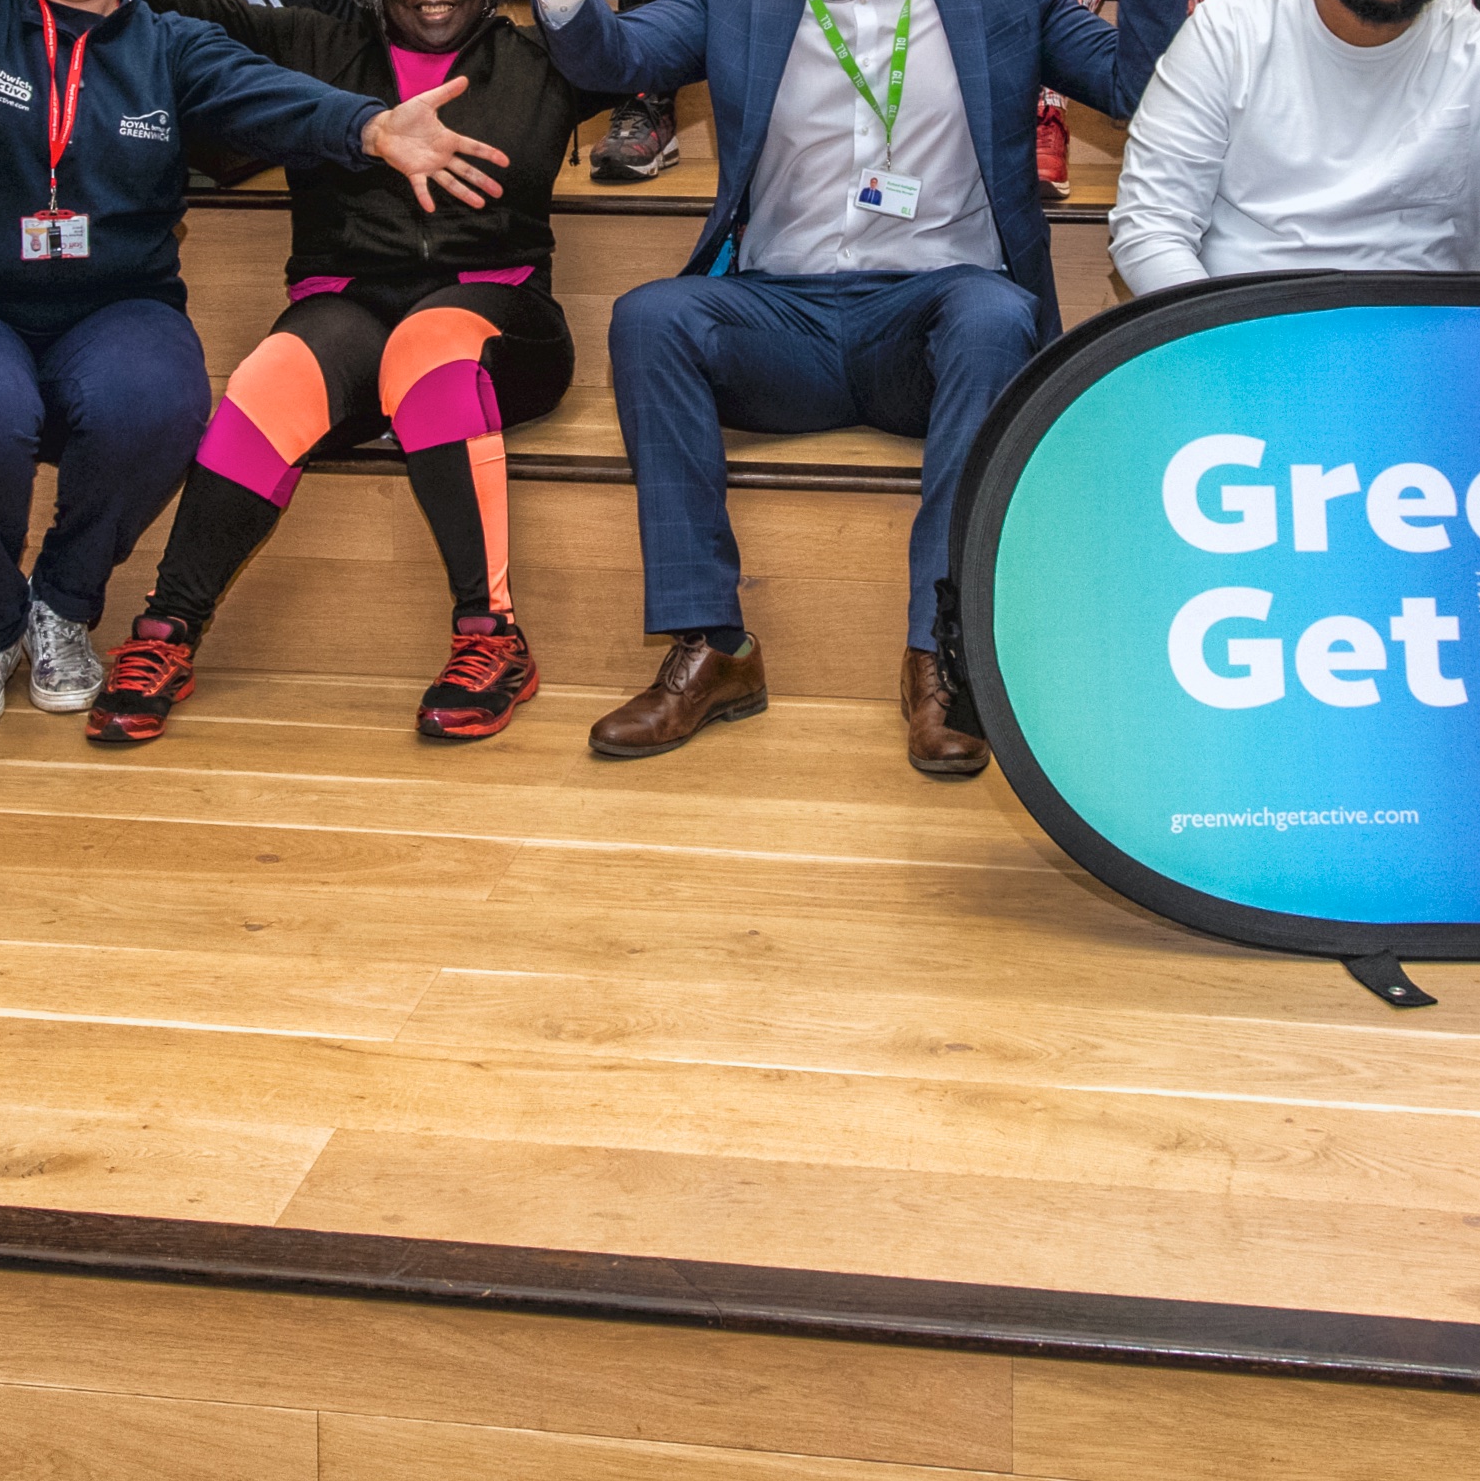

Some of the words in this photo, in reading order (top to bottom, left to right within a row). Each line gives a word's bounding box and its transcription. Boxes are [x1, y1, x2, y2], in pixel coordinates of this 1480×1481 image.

[820, 14, 833, 30] GLL
[835, 42, 848, 59] GLL
[895, 37, 907, 52] GLL
[853, 71, 865, 88] GLL
[891, 70, 903, 85] GLL
[888, 104, 897, 118] GLL
[120, 120, 150, 131] ROYAL
[1167, 586, 1467, 710] Get
[1170, 806, 1420, 834] greenwichgetactive.com
